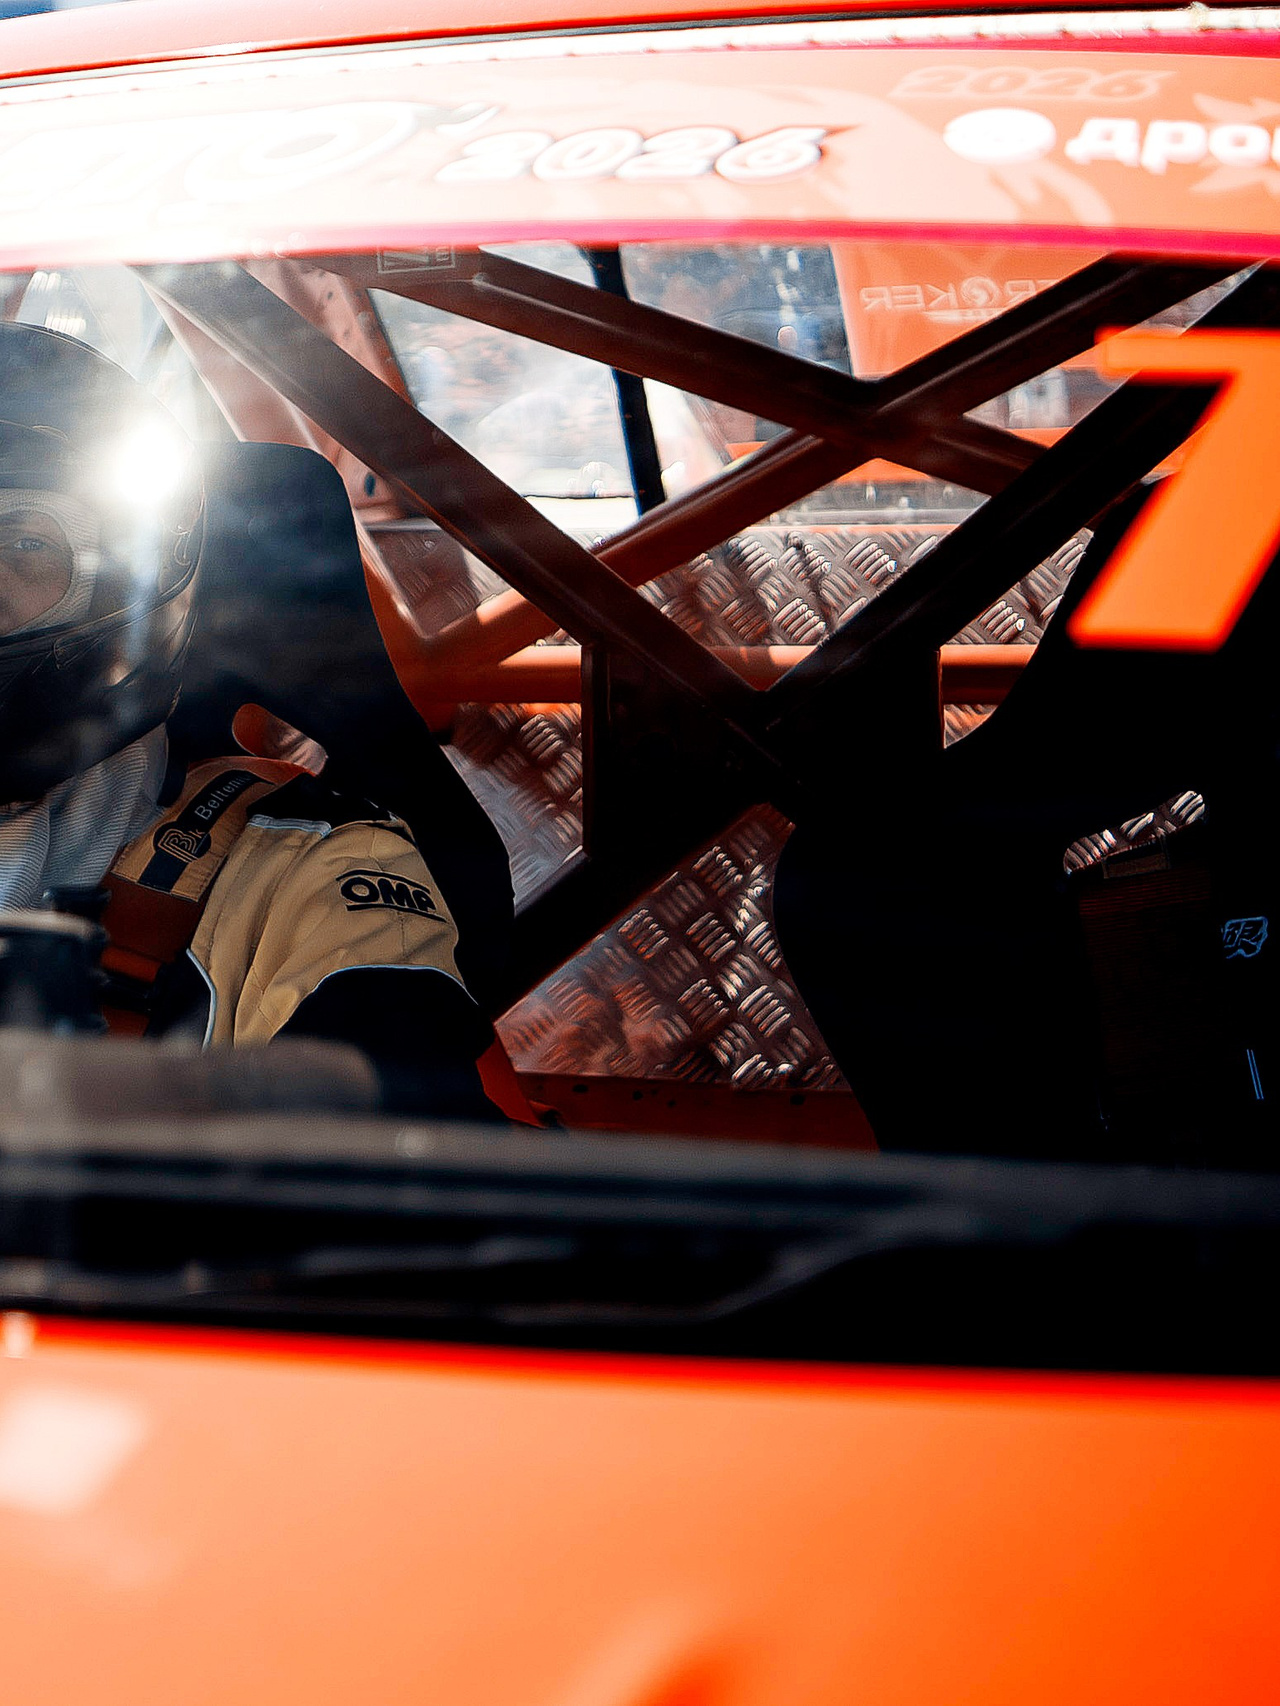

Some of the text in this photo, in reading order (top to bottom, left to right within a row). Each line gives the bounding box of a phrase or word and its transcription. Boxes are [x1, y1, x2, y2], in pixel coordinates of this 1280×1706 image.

[433, 125, 838, 184] 2026
[1064, 116, 1280, 176] дро
[339, 875, 438, 913] OMP
